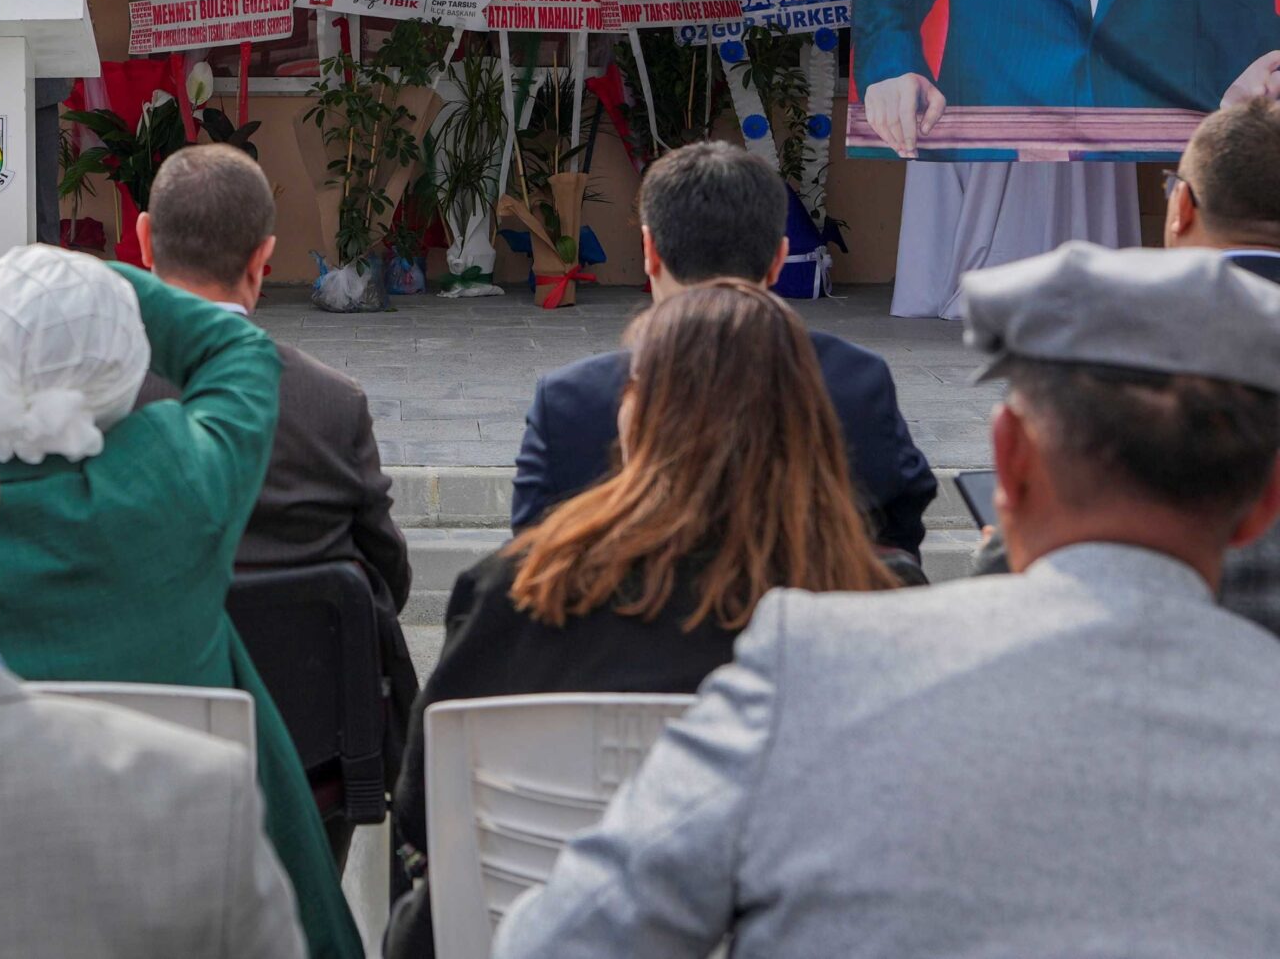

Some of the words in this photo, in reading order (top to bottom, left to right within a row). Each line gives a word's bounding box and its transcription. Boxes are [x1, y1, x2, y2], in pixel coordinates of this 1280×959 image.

[153, 1, 197, 25] MEHMET
[431, 0, 446, 7] CHP
[448, 1, 477, 9] TARSUS
[488, 4, 535, 28] ATATÜRK
[620, 5, 642, 23] MHP
[644, 3, 682, 21] TARSUS
[703, 0, 743, 22] BAŞKANI
[762, 6, 849, 31] TÜRKER
